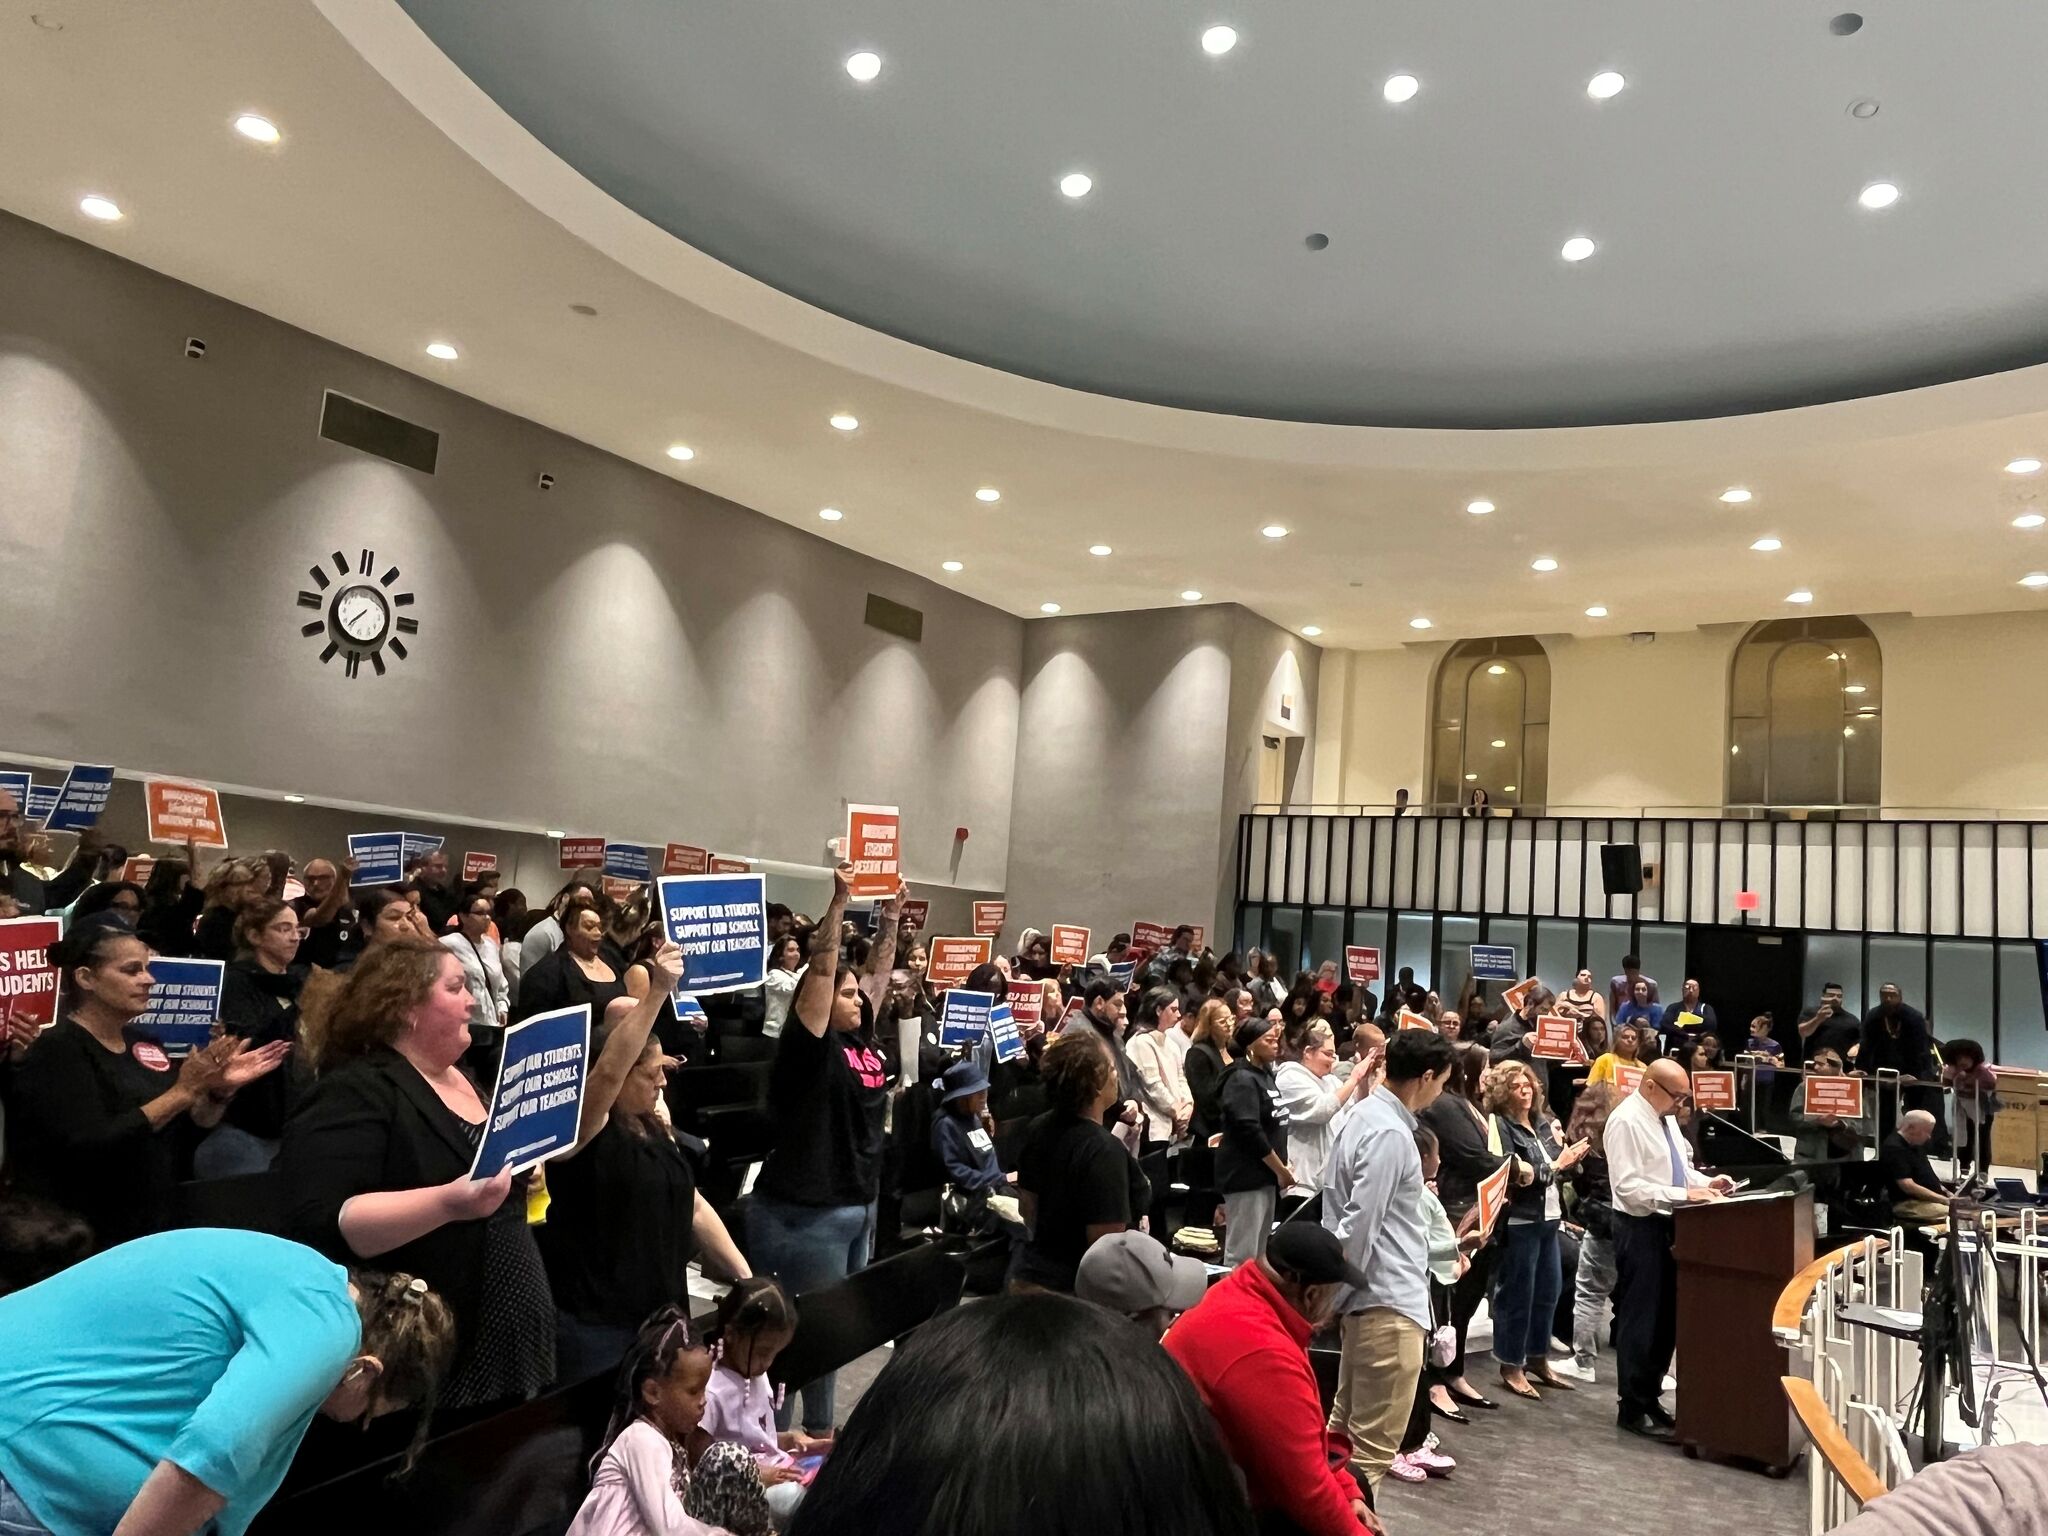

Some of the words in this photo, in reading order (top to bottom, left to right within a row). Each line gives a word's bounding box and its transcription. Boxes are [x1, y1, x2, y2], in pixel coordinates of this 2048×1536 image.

[669, 905, 708, 922] SUPPORT
[708, 904, 724, 919] OUR
[674, 922, 712, 939] SUPPORT
[712, 922, 728, 936] OUR
[679, 941, 711, 956] UPPORT
[711, 939, 727, 953] OUR
[526, 1052, 543, 1073] OUR
[524, 1074, 542, 1094] OUR
[520, 1096, 538, 1118] OUR
